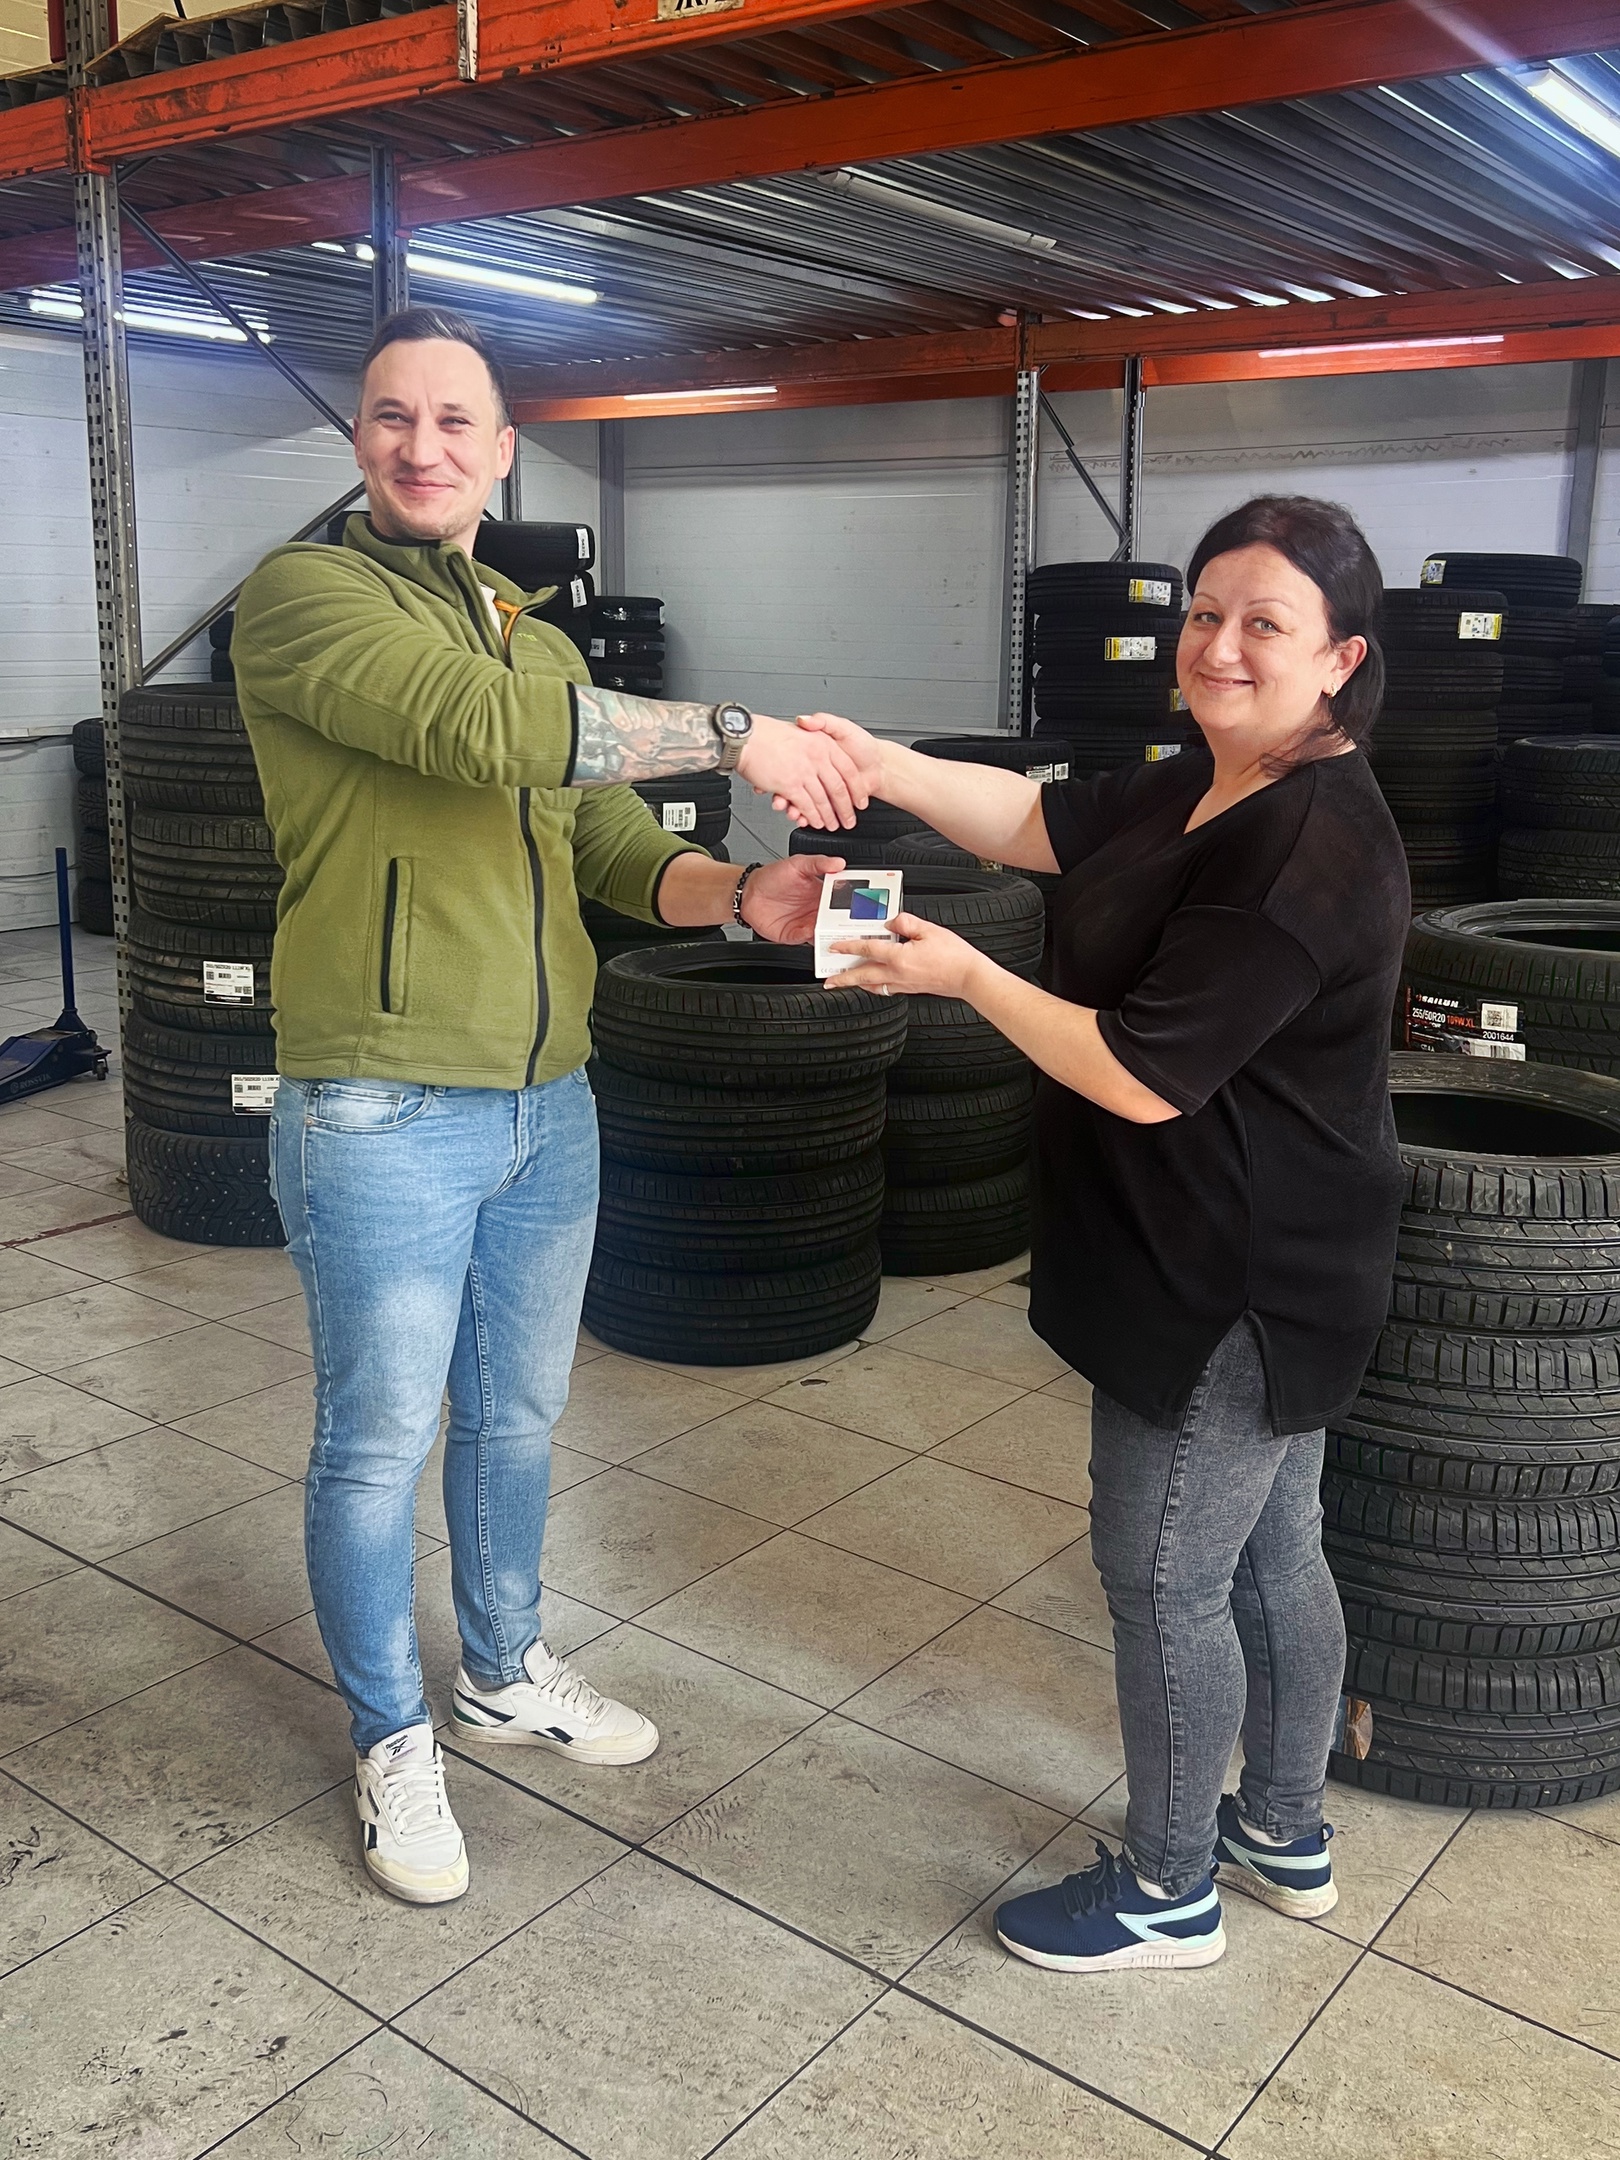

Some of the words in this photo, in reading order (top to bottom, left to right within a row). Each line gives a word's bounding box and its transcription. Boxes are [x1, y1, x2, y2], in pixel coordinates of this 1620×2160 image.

[1422, 995, 1459, 1008] SAILUN
[1412, 1007, 1446, 1024] 255/50R20
[1465, 1018, 1476, 1028] XL
[1482, 1031, 1515, 1042] 2001644
[385, 1734, 409, 1749] Reebok
